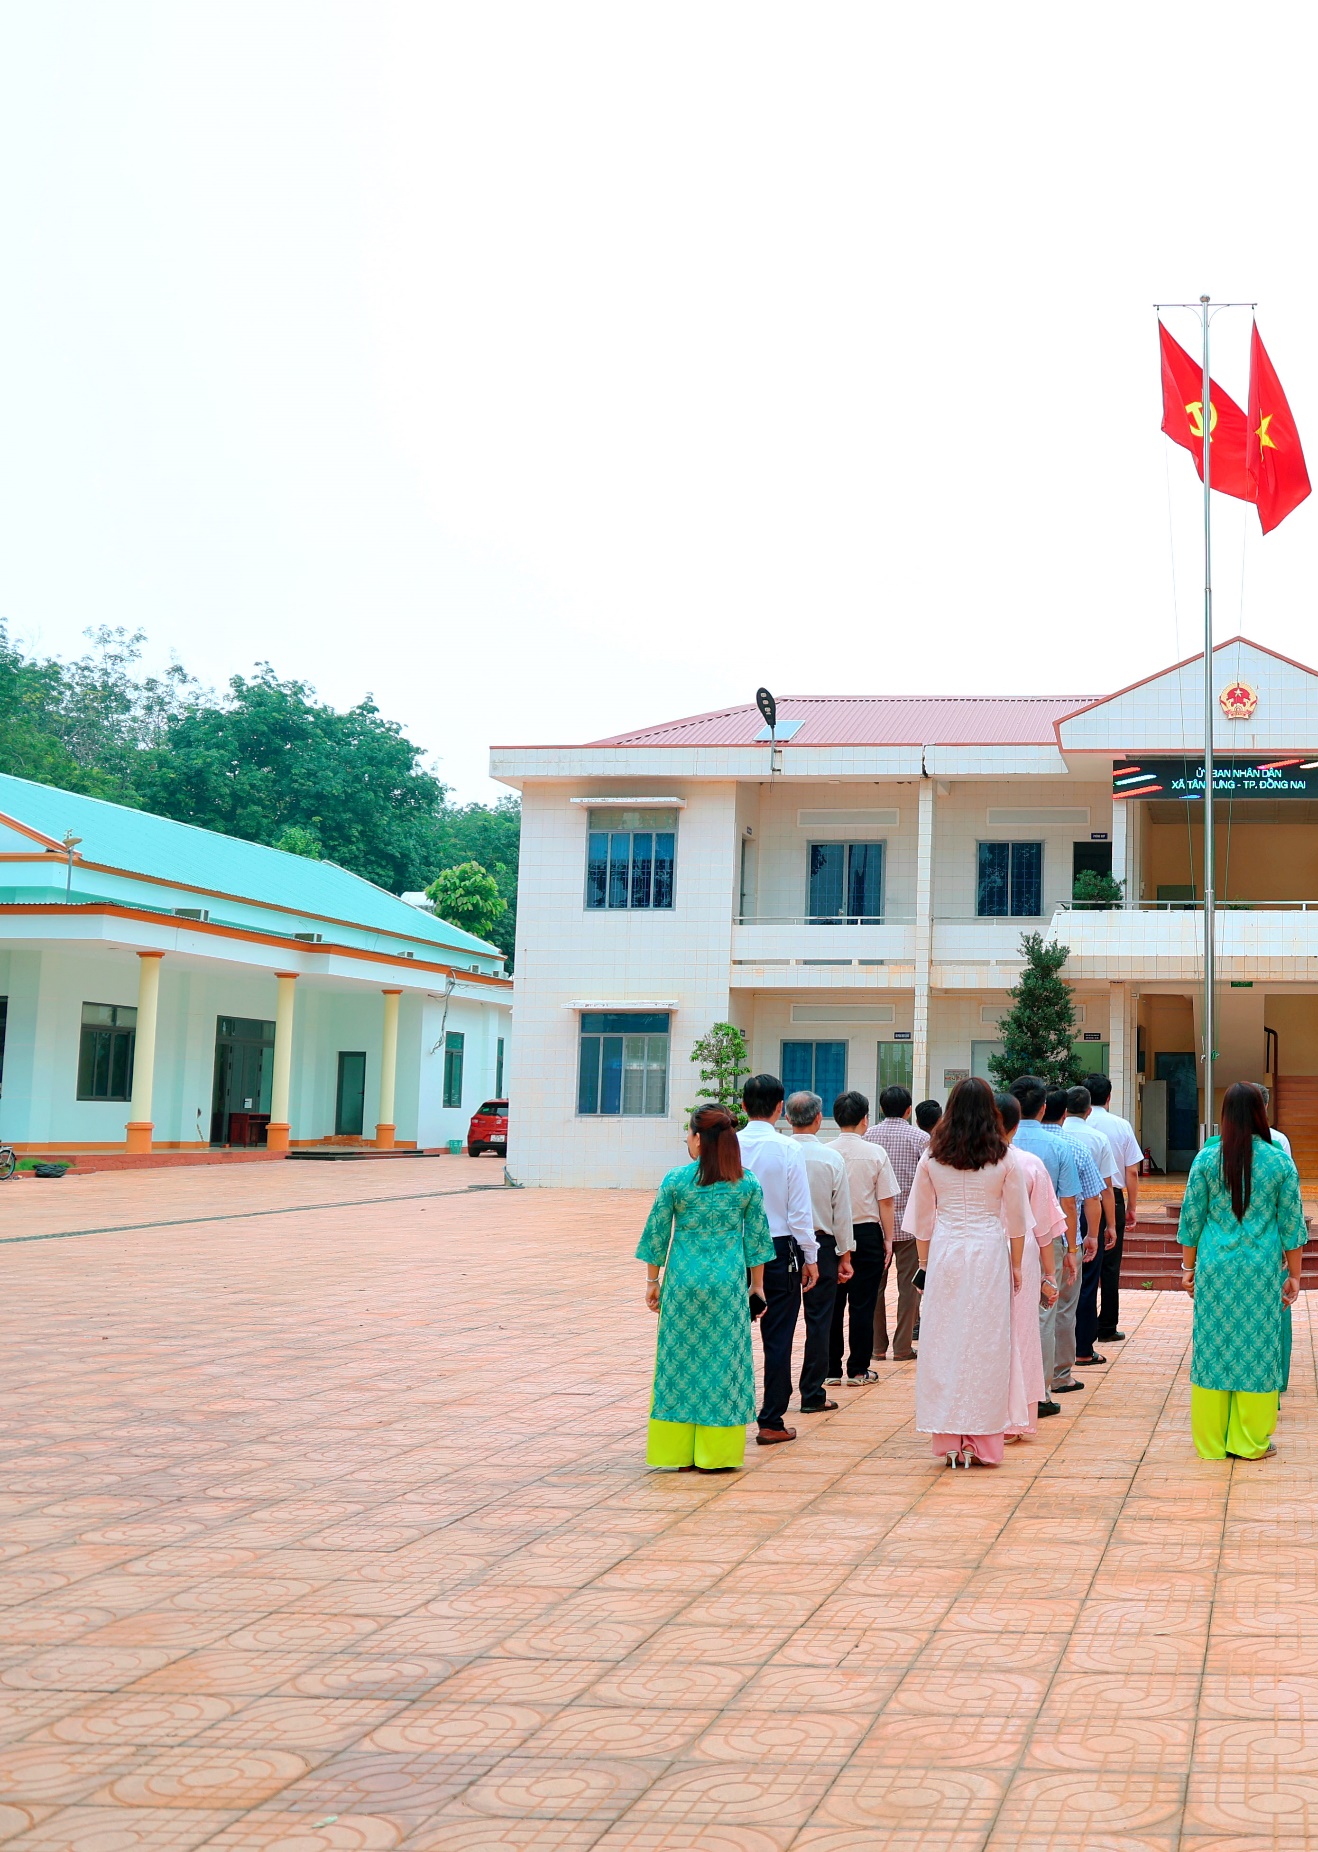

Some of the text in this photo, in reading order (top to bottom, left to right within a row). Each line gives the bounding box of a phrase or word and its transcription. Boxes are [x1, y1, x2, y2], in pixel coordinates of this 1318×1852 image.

[1233, 767, 1260, 778] NHÂN
[1261, 767, 1282, 778] DÂN
[1171, 778, 1186, 789] XÃ
[1186, 778, 1206, 789] TÂN
[1243, 780, 1257, 789] TP.
[1259, 778, 1289, 789] ĐỒNG
[1290, 780, 1306, 789] NAI
